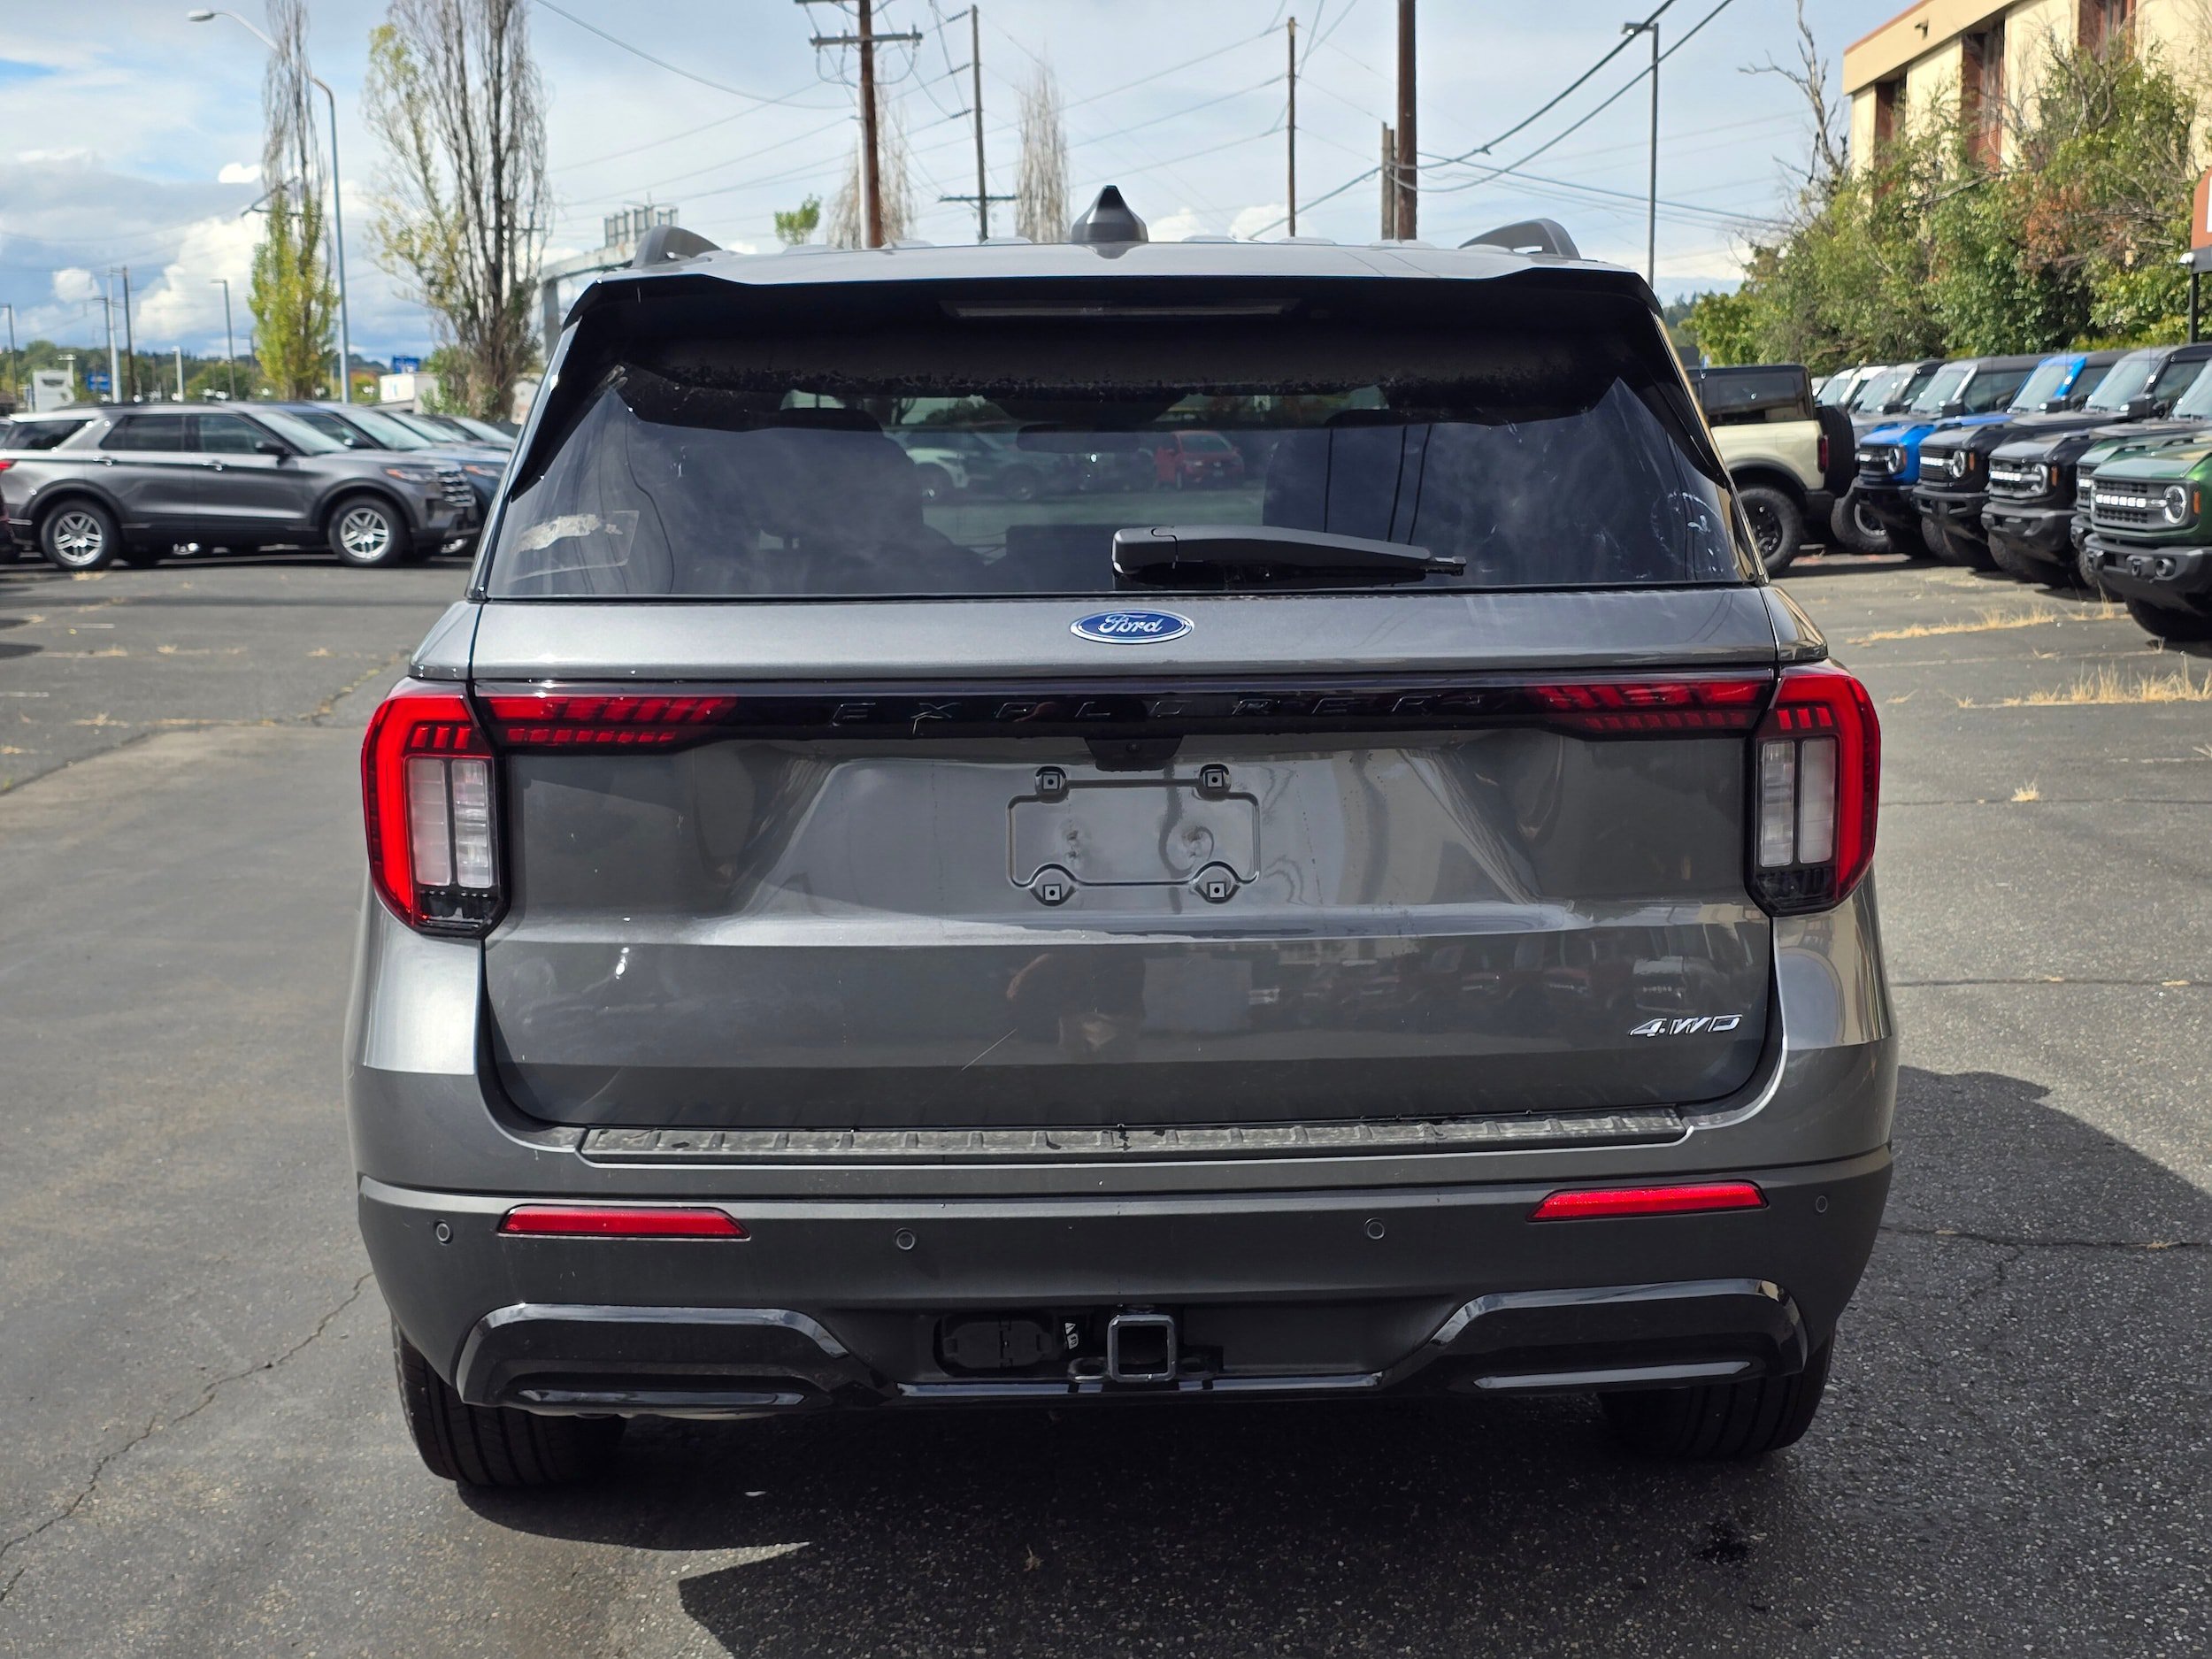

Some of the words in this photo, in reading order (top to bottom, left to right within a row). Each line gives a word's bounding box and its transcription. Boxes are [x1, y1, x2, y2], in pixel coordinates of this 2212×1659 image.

[1097, 613, 1164, 633] Ford
[832, 696, 1435, 722] EXPLORER
[1630, 1014, 1743, 1037] 4WD
